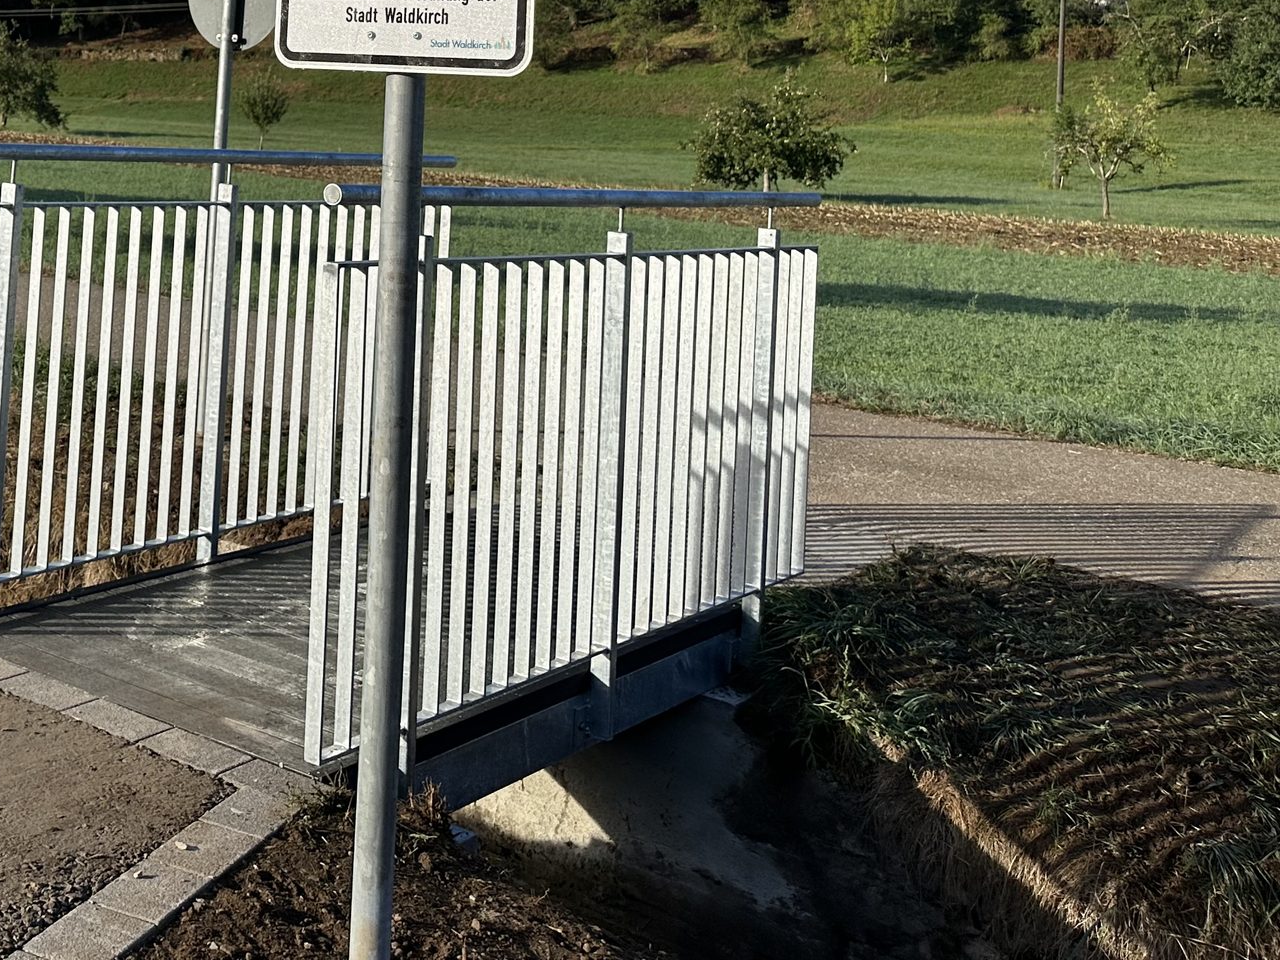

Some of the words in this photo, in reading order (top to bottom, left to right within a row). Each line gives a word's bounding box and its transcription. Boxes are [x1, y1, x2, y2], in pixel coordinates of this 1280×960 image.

[345, 7, 378, 23] Stadt
[384, 8, 449, 25] Waldkirch
[430, 39, 450, 49] Stadt
[451, 39, 492, 50] Waldkirch
